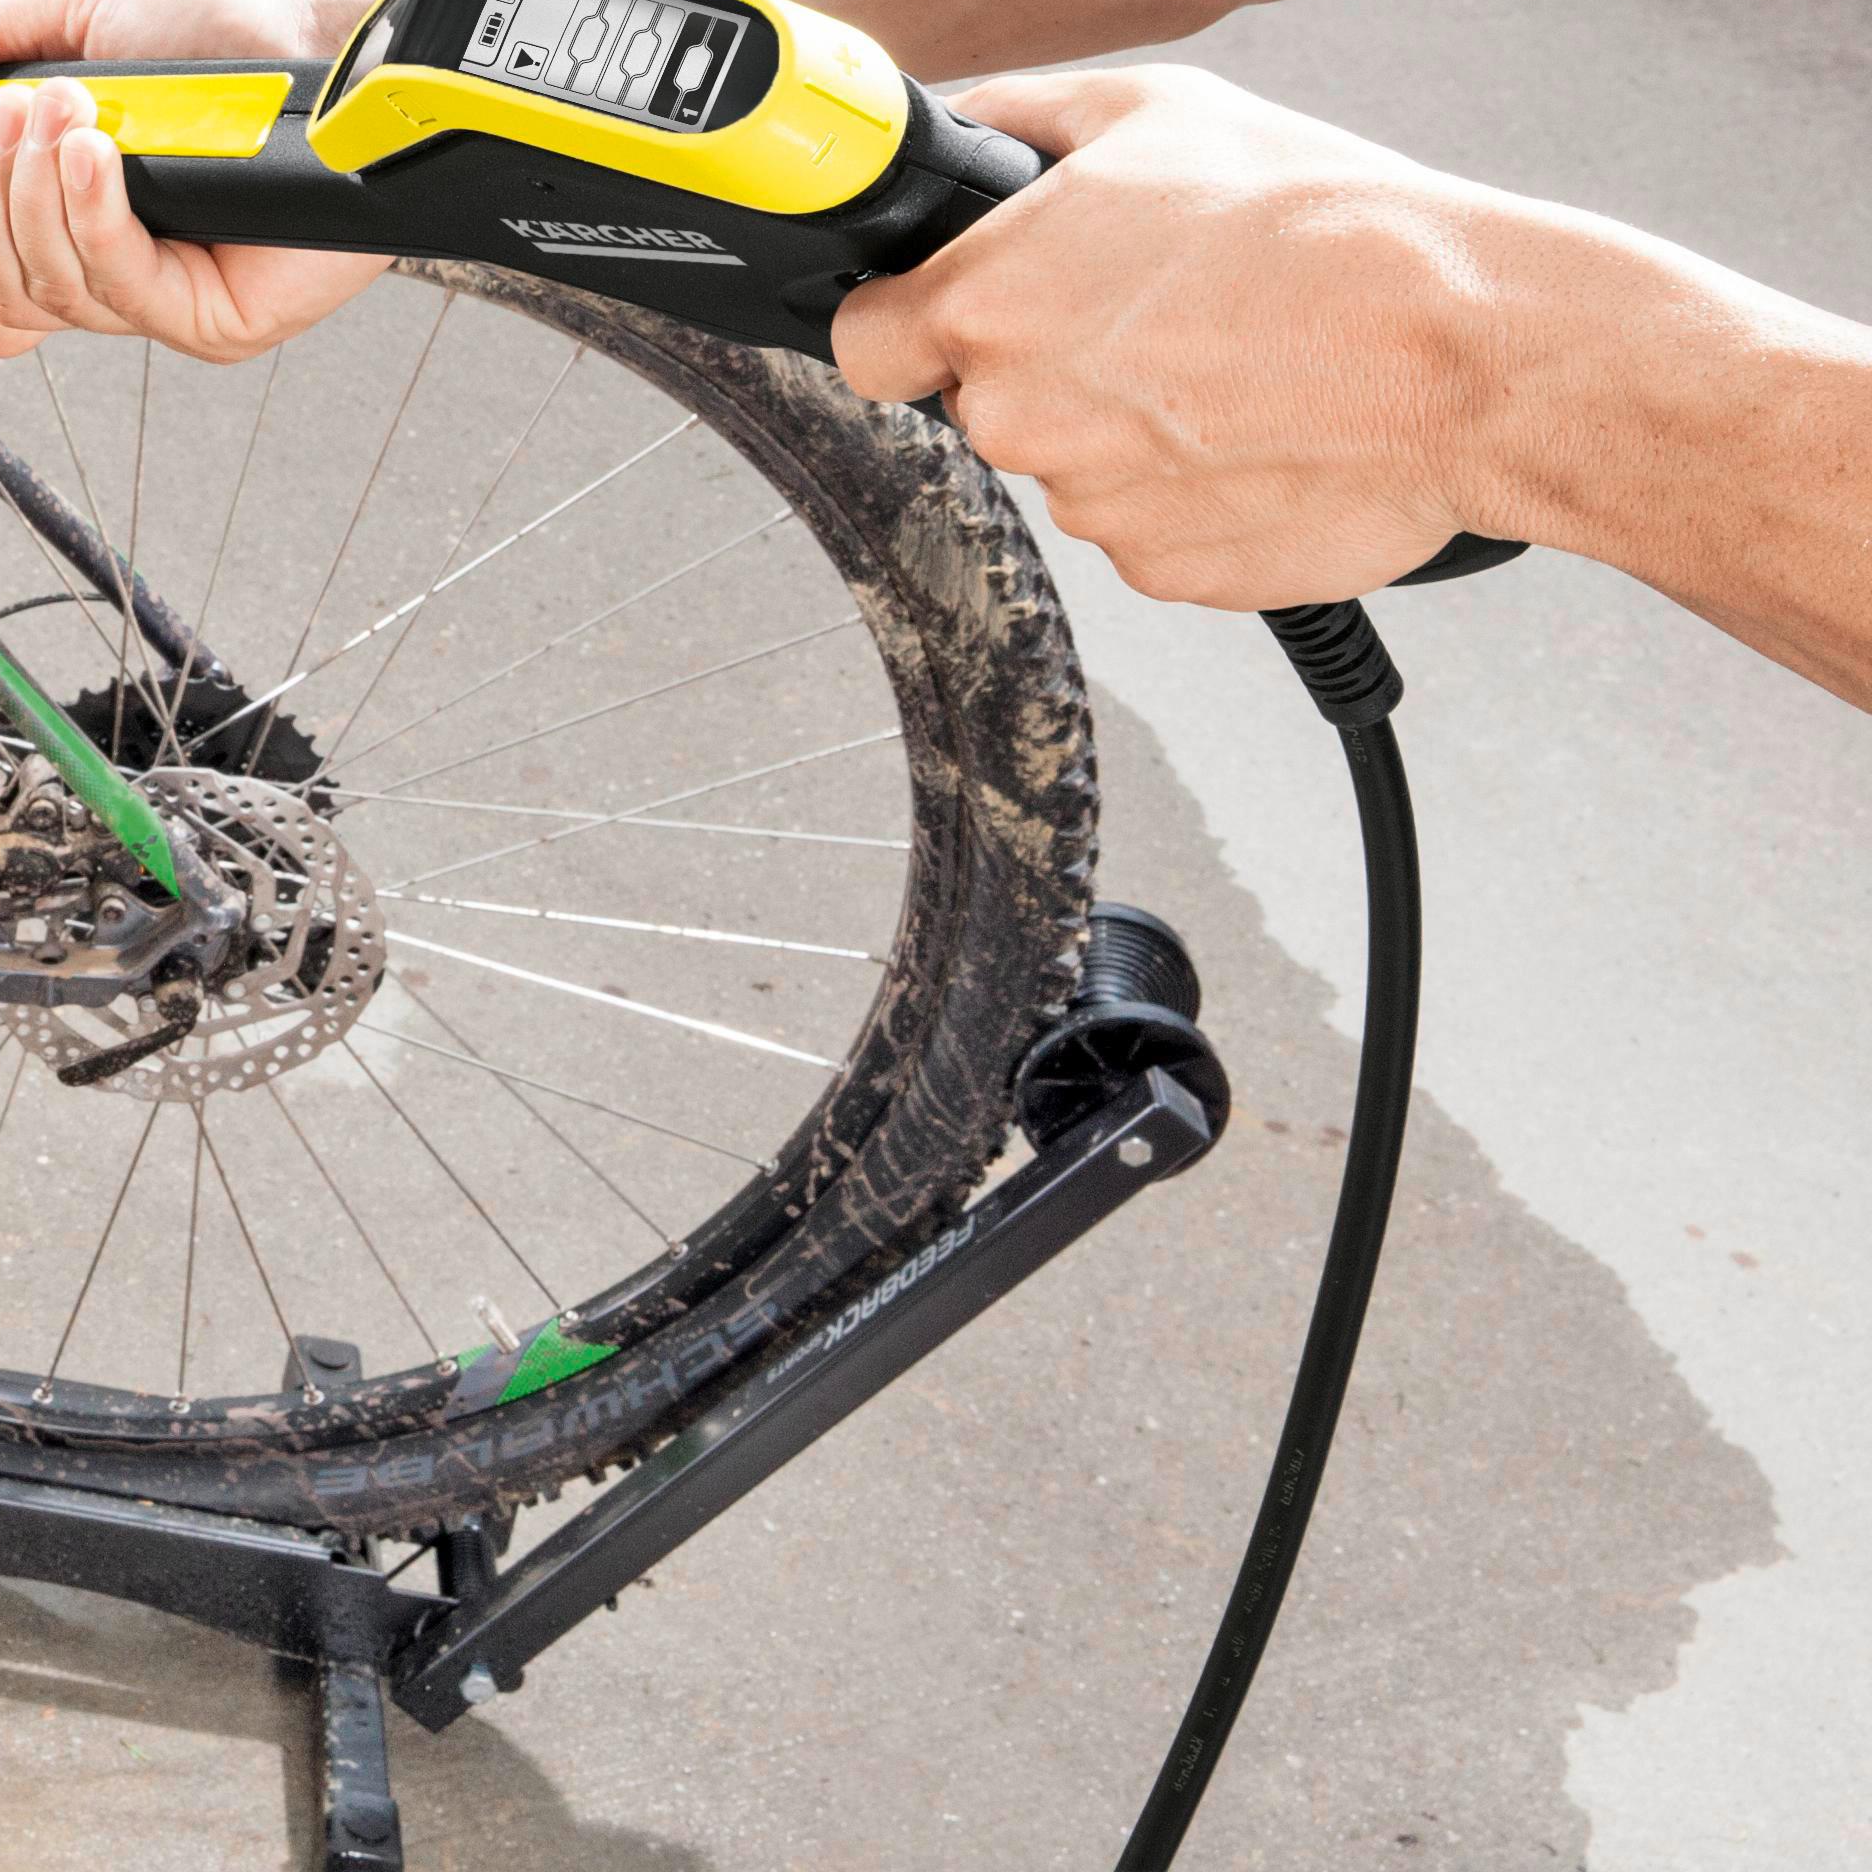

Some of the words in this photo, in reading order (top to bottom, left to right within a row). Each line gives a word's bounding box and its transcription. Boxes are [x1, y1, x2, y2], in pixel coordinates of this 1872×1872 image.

[682, 107, 699, 118] 1
[499, 218, 728, 251] KÄRCHER
[823, 1213, 977, 1351] FEEDBACK
